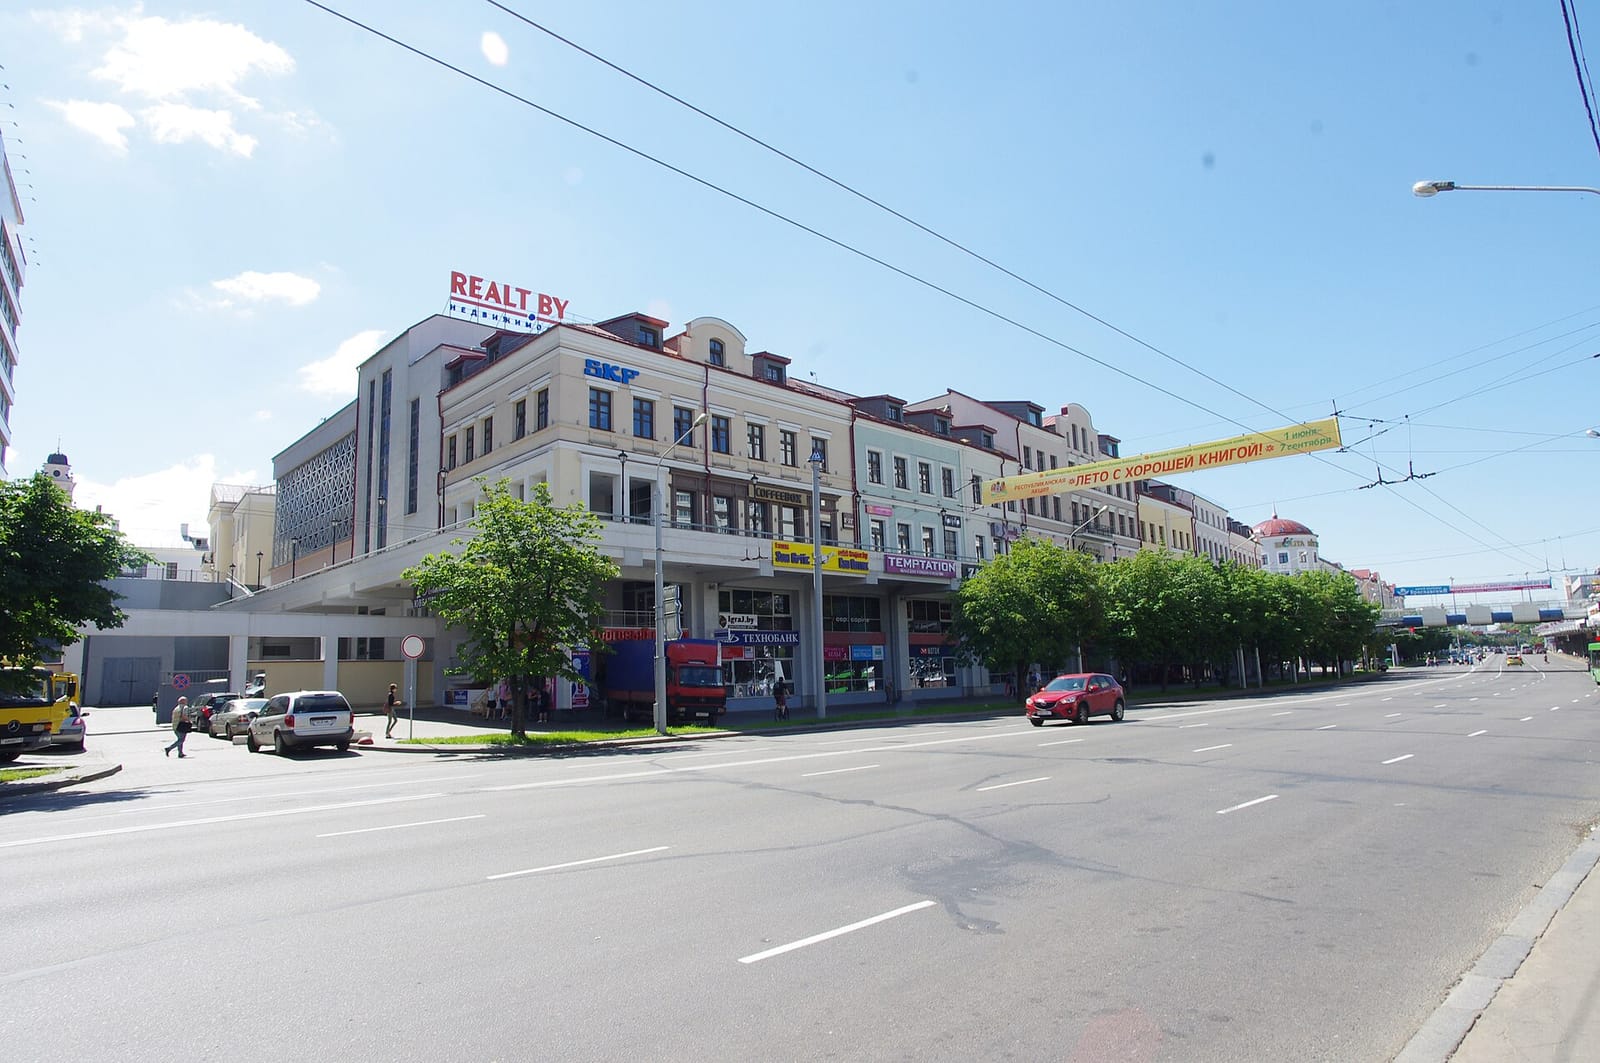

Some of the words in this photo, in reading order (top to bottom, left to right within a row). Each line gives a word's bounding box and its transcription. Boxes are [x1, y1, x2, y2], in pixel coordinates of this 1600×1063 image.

[584, 358, 640, 385] SKF
[1280, 442, 1287, 452] 7
[1074, 470, 1109, 487] ЛЕТО
[1112, 469, 1122, 480] С
[1125, 455, 1194, 478] ХОРОШЕЙ
[1198, 442, 1263, 466] КНИГОЙ!
[755, 486, 802, 504] COFFEEBOX
[887, 556, 956, 573] TEMPTATION
[742, 633, 799, 643] ТЕХНОБАНК
